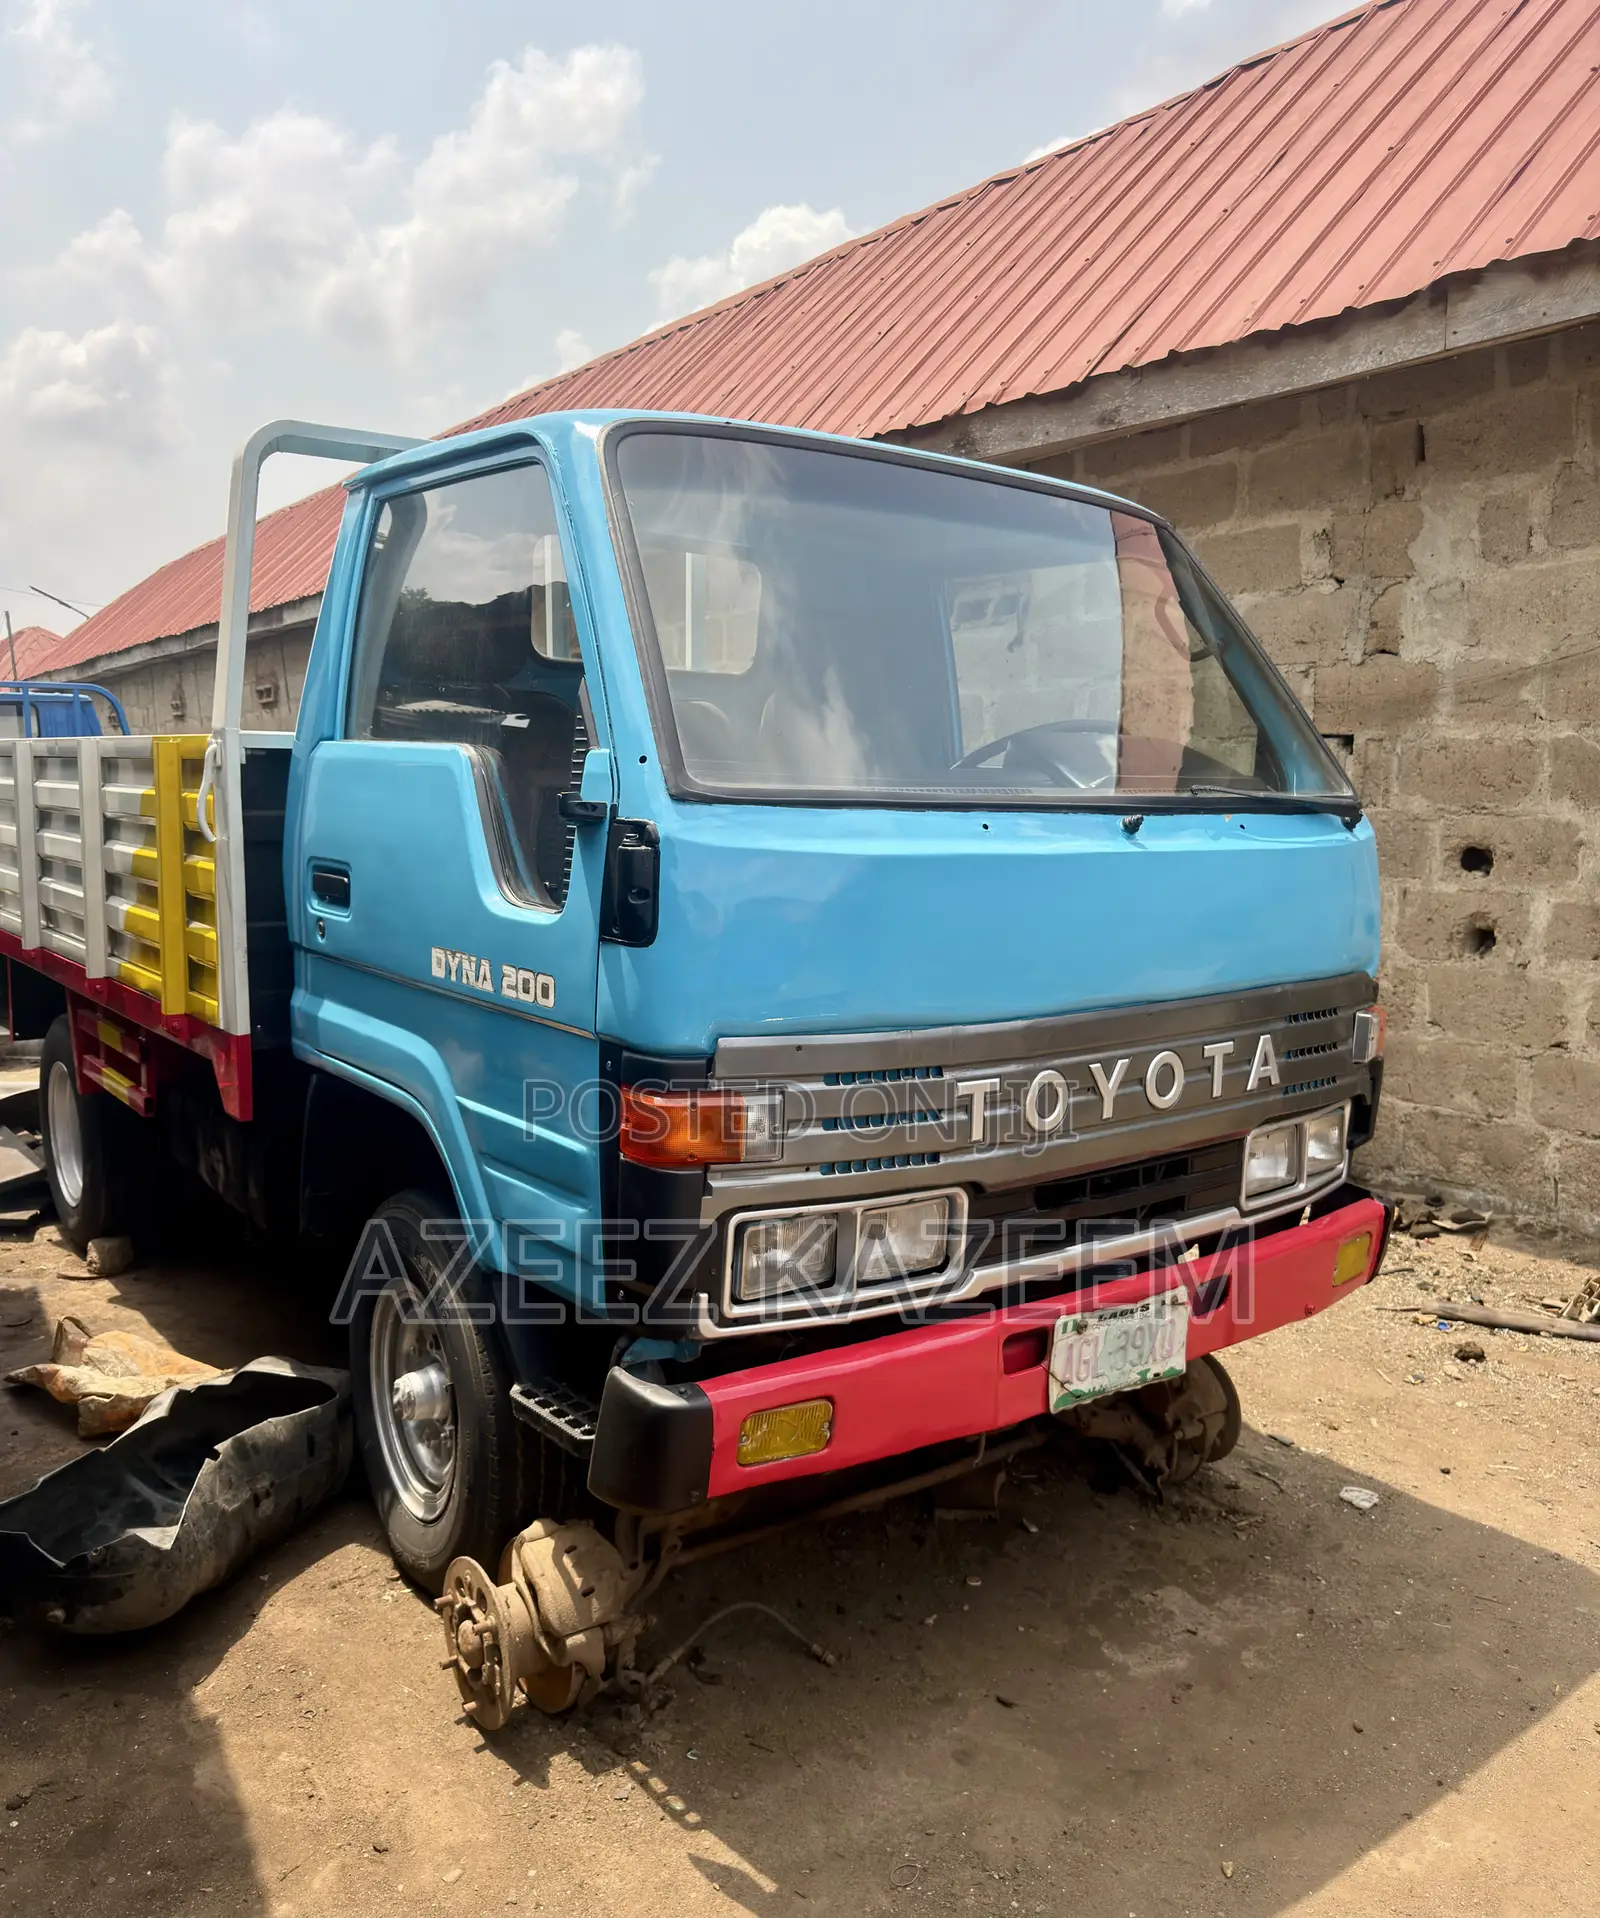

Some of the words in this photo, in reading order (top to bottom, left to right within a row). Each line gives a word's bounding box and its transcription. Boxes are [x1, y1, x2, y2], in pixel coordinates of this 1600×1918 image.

[432, 946, 495, 993] DYNA
[501, 964, 556, 1009] 200
[956, 1033, 1282, 1143] TOYOTA
